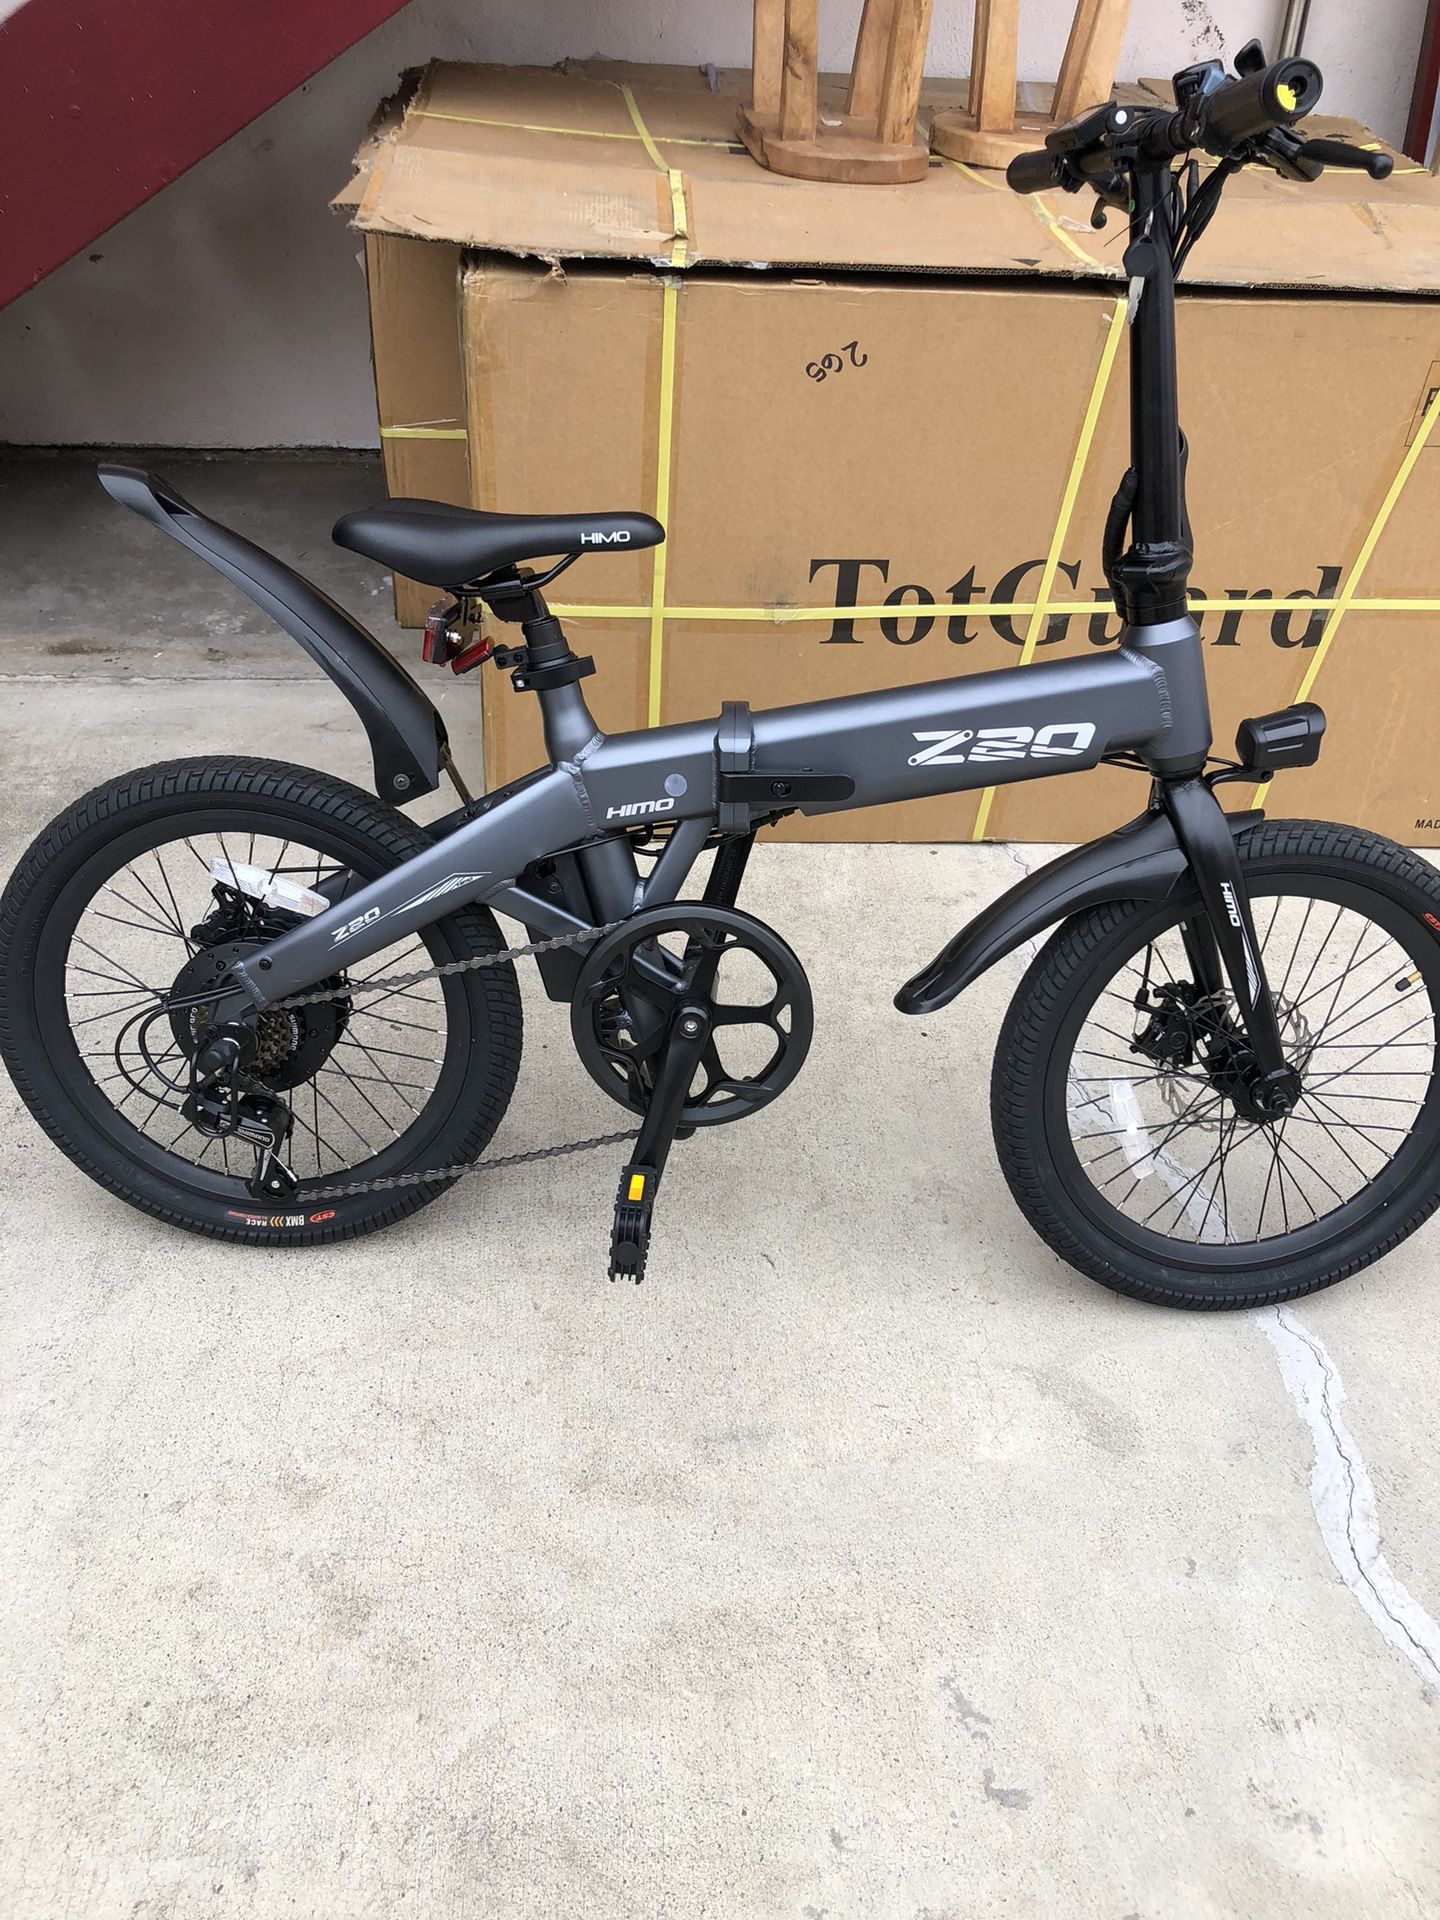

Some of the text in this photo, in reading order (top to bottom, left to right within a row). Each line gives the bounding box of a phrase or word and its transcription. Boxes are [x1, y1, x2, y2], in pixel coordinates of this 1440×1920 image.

[580, 530, 631, 544] HIMO
[907, 722, 1097, 767] Z20
[606, 797, 675, 819] HIMO
[1220, 882, 1241, 927] HIMO
[331, 906, 381, 943] Z20
[285, 1213, 305, 1227] BMX
